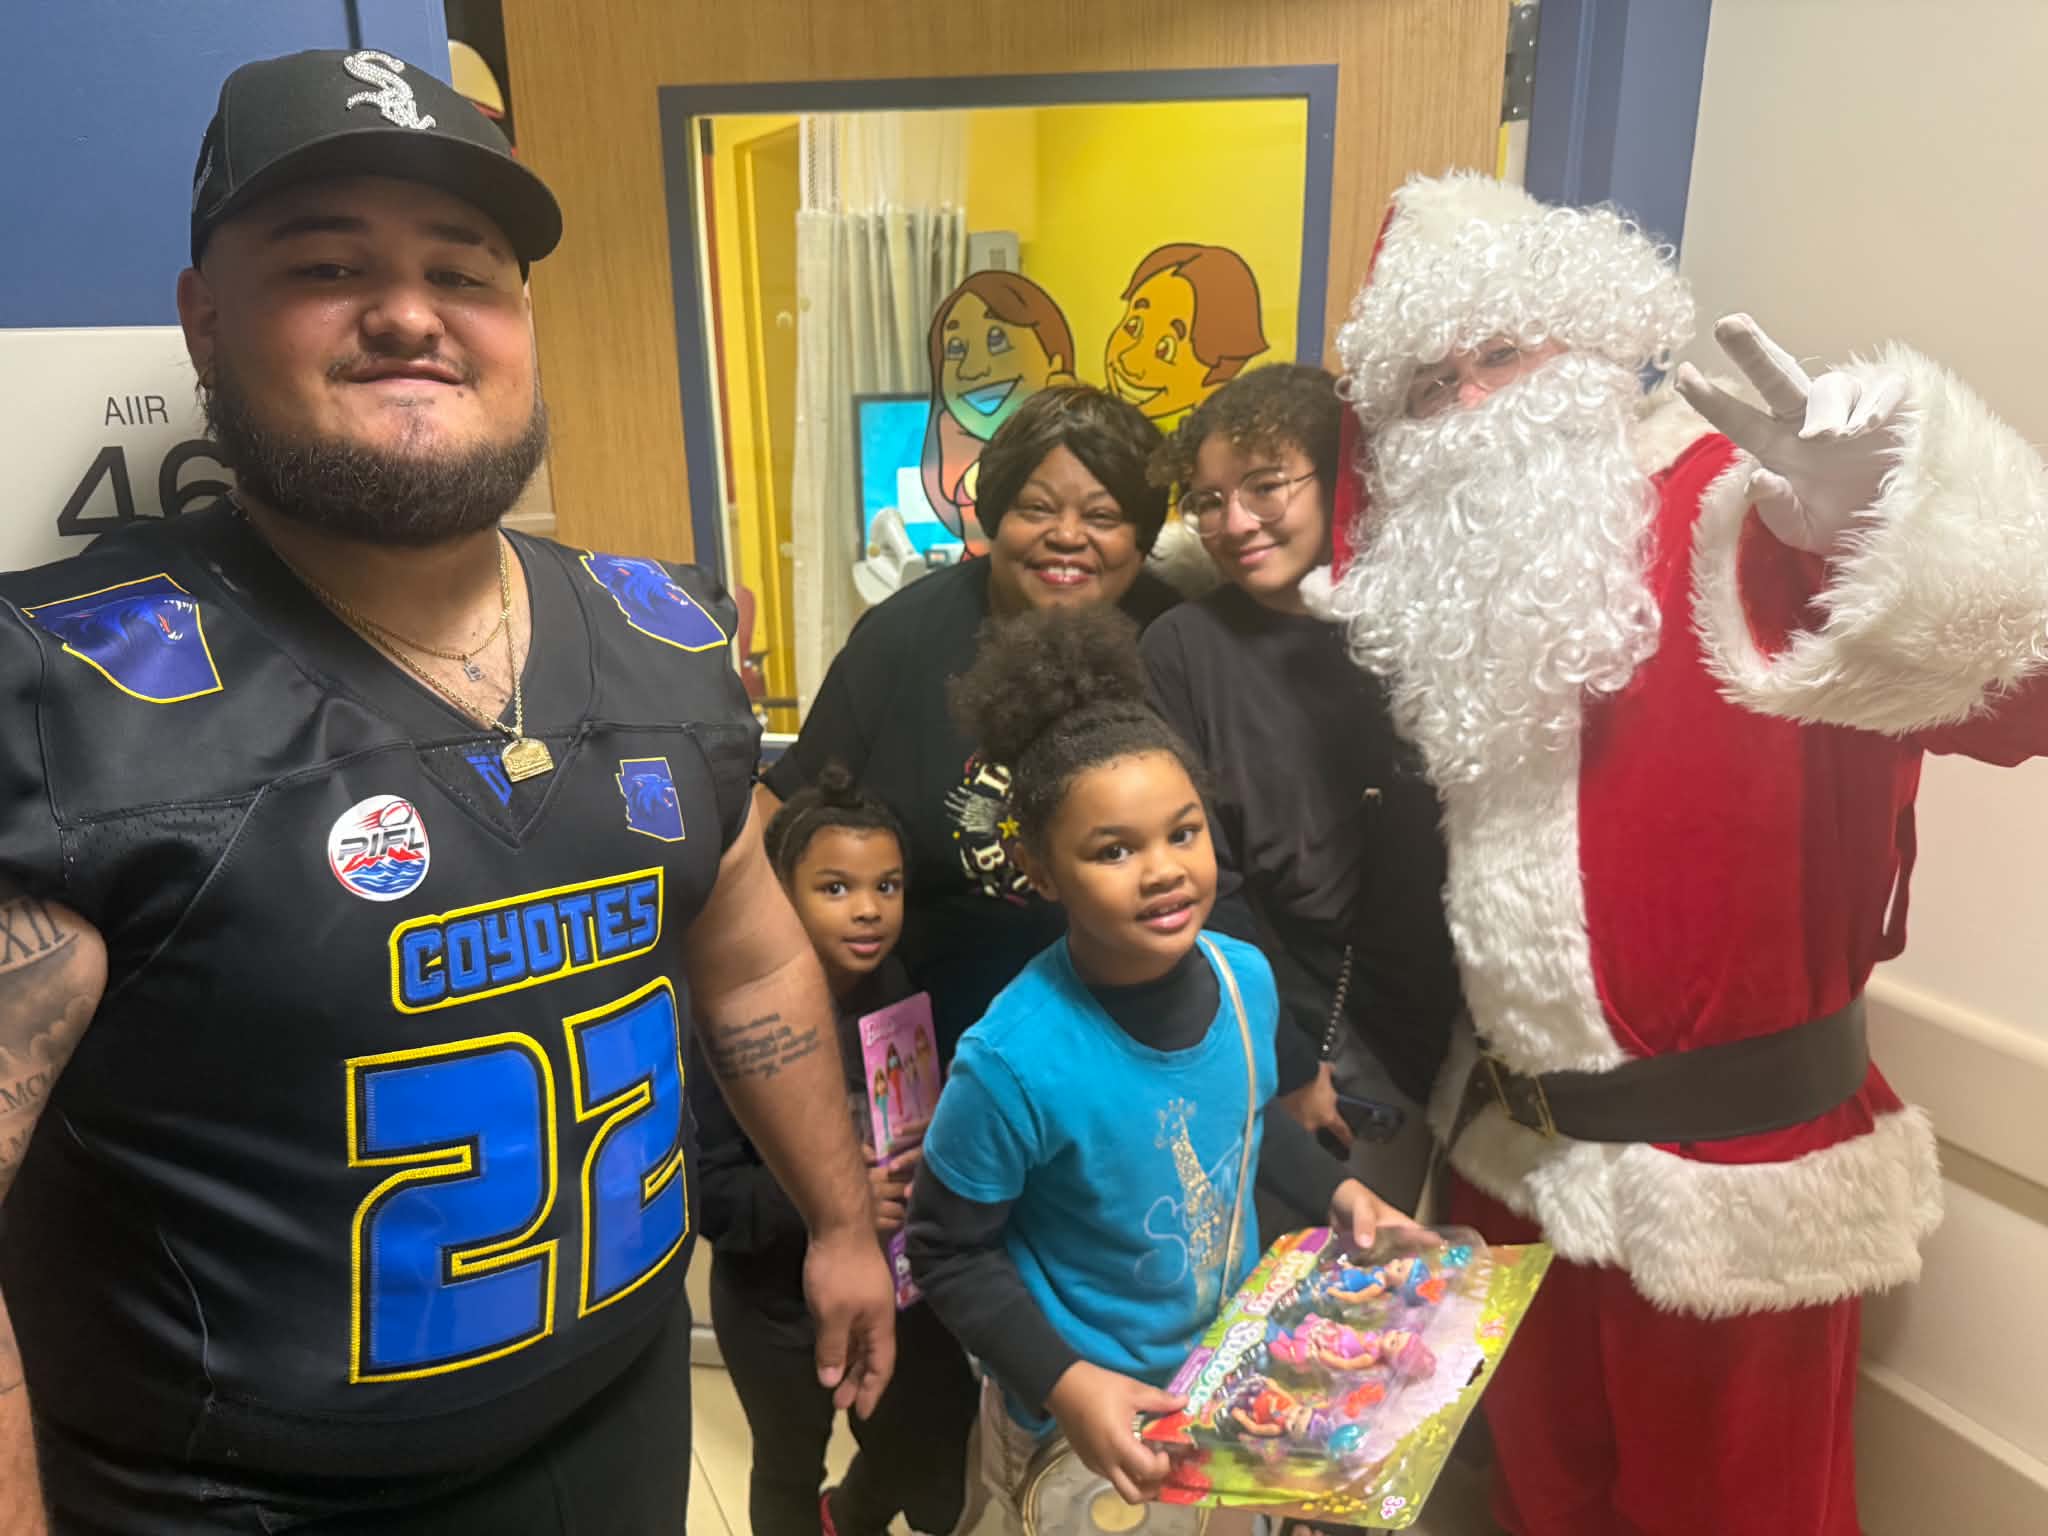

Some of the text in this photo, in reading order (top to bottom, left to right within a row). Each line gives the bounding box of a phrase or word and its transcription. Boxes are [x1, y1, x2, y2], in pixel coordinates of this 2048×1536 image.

[104, 395, 169, 426] AIIR
[336, 826, 425, 861] PIFL
[400, 878, 658, 1004] COYOTES
[348, 980, 689, 1382] 22
